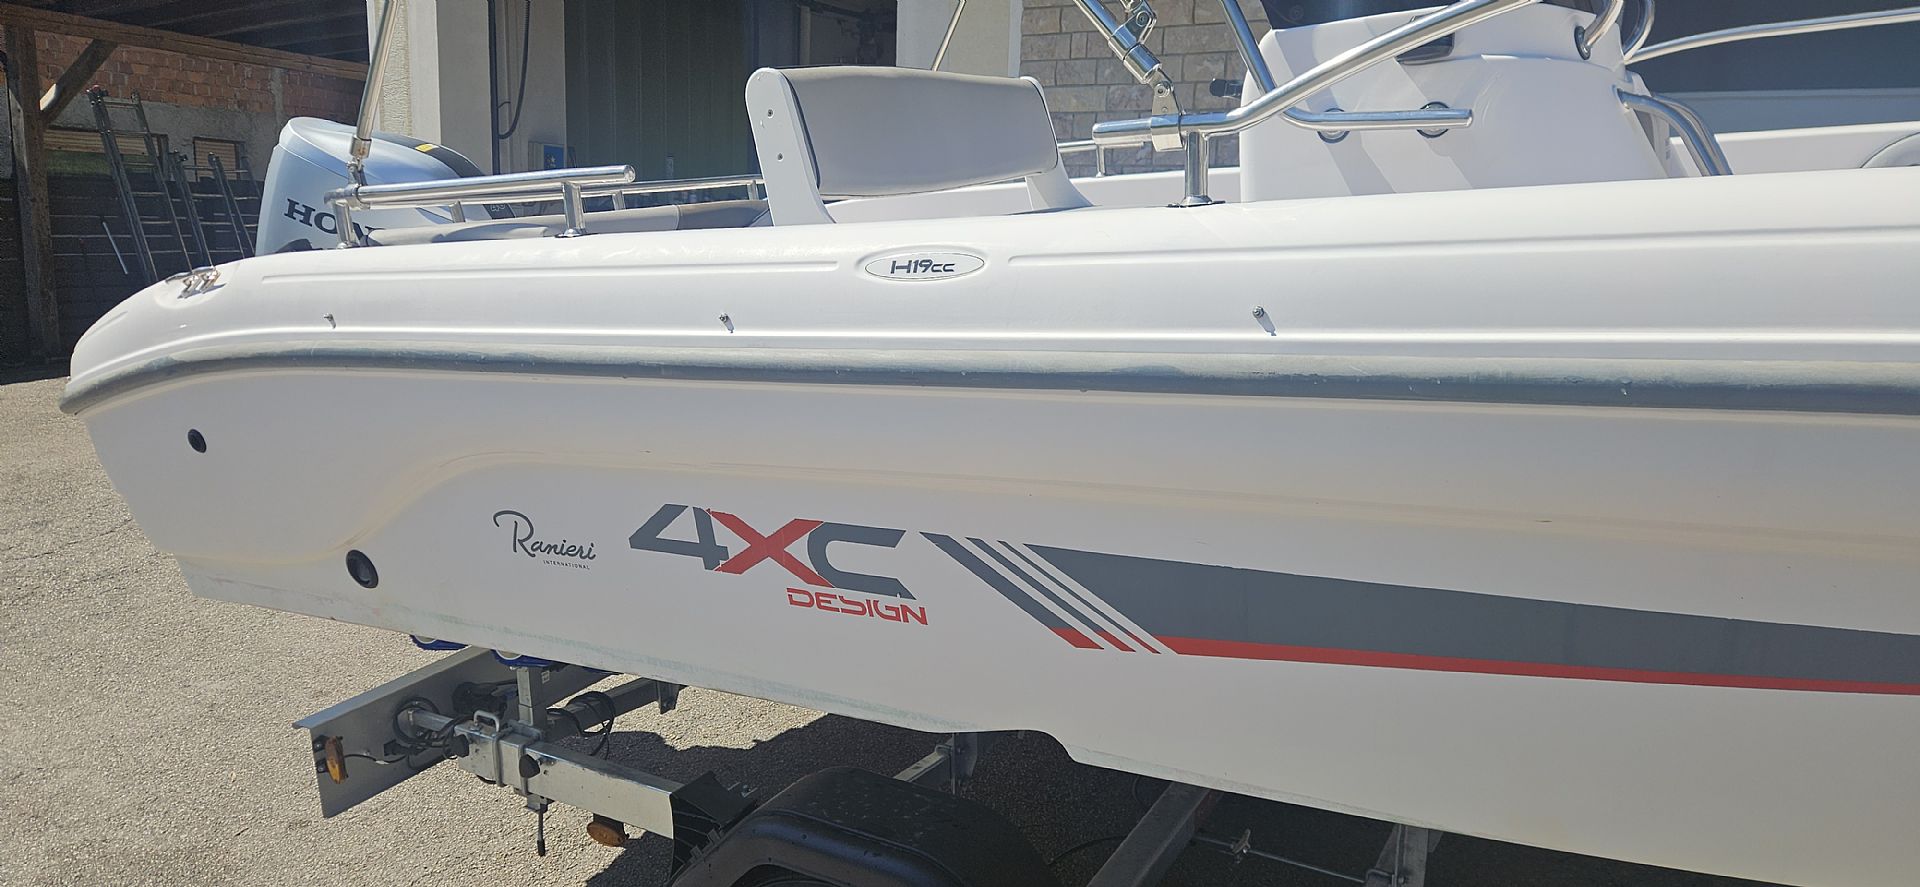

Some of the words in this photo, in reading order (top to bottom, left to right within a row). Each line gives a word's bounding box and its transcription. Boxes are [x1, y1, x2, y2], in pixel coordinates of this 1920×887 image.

[492, 510, 596, 560] Ranieri
[628, 503, 917, 600] 4XC
[543, 560, 590, 570] INTERNATIONAL
[787, 587, 929, 626] DESIGN
